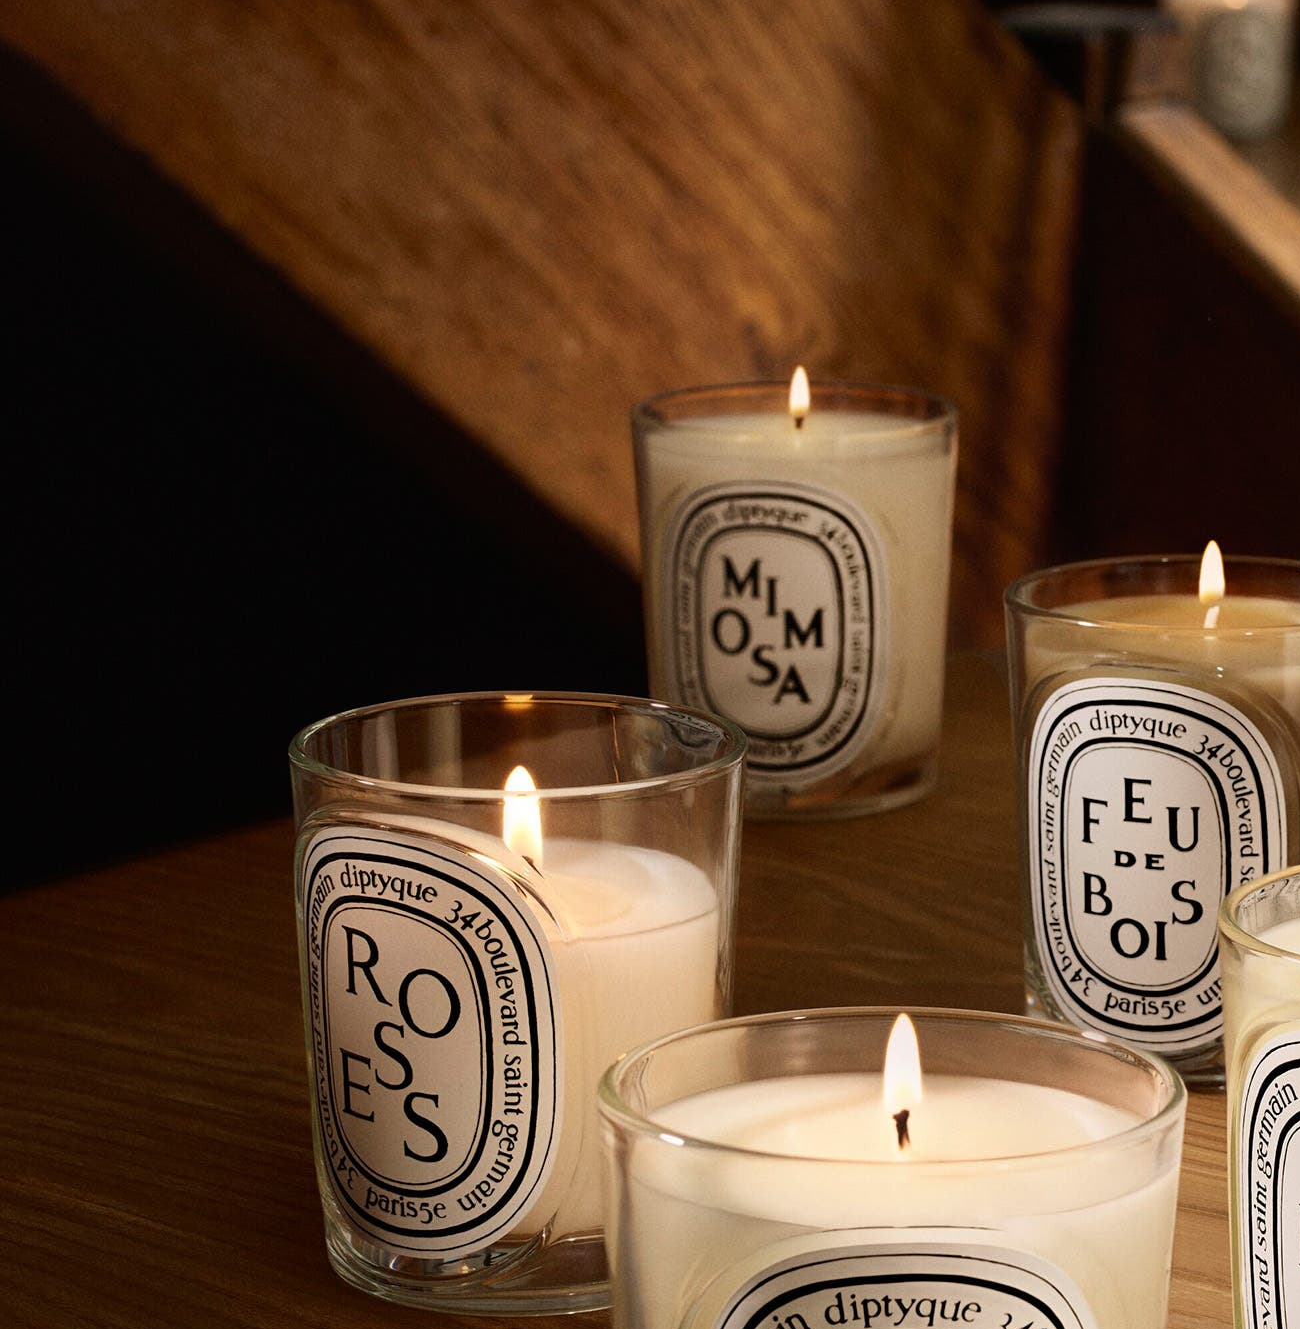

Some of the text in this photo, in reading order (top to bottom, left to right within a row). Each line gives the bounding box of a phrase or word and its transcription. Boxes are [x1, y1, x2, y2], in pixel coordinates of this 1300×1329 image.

[1045, 720, 1082, 797] germain
[1089, 710, 1187, 739] diptyque
[1045, 800, 1055, 854] saint
[1081, 778, 1200, 852] FEU
[340, 862, 439, 904] diptyque
[1114, 850, 1165, 871] DE
[1082, 872, 1204, 961] BOIS
[503, 1052, 529, 1117] saint
[1256, 1082, 1298, 1179] germain
[457, 1119, 521, 1213] germain
[1255, 1181, 1267, 1252] saint
[823, 1292, 982, 1327] diptyque
